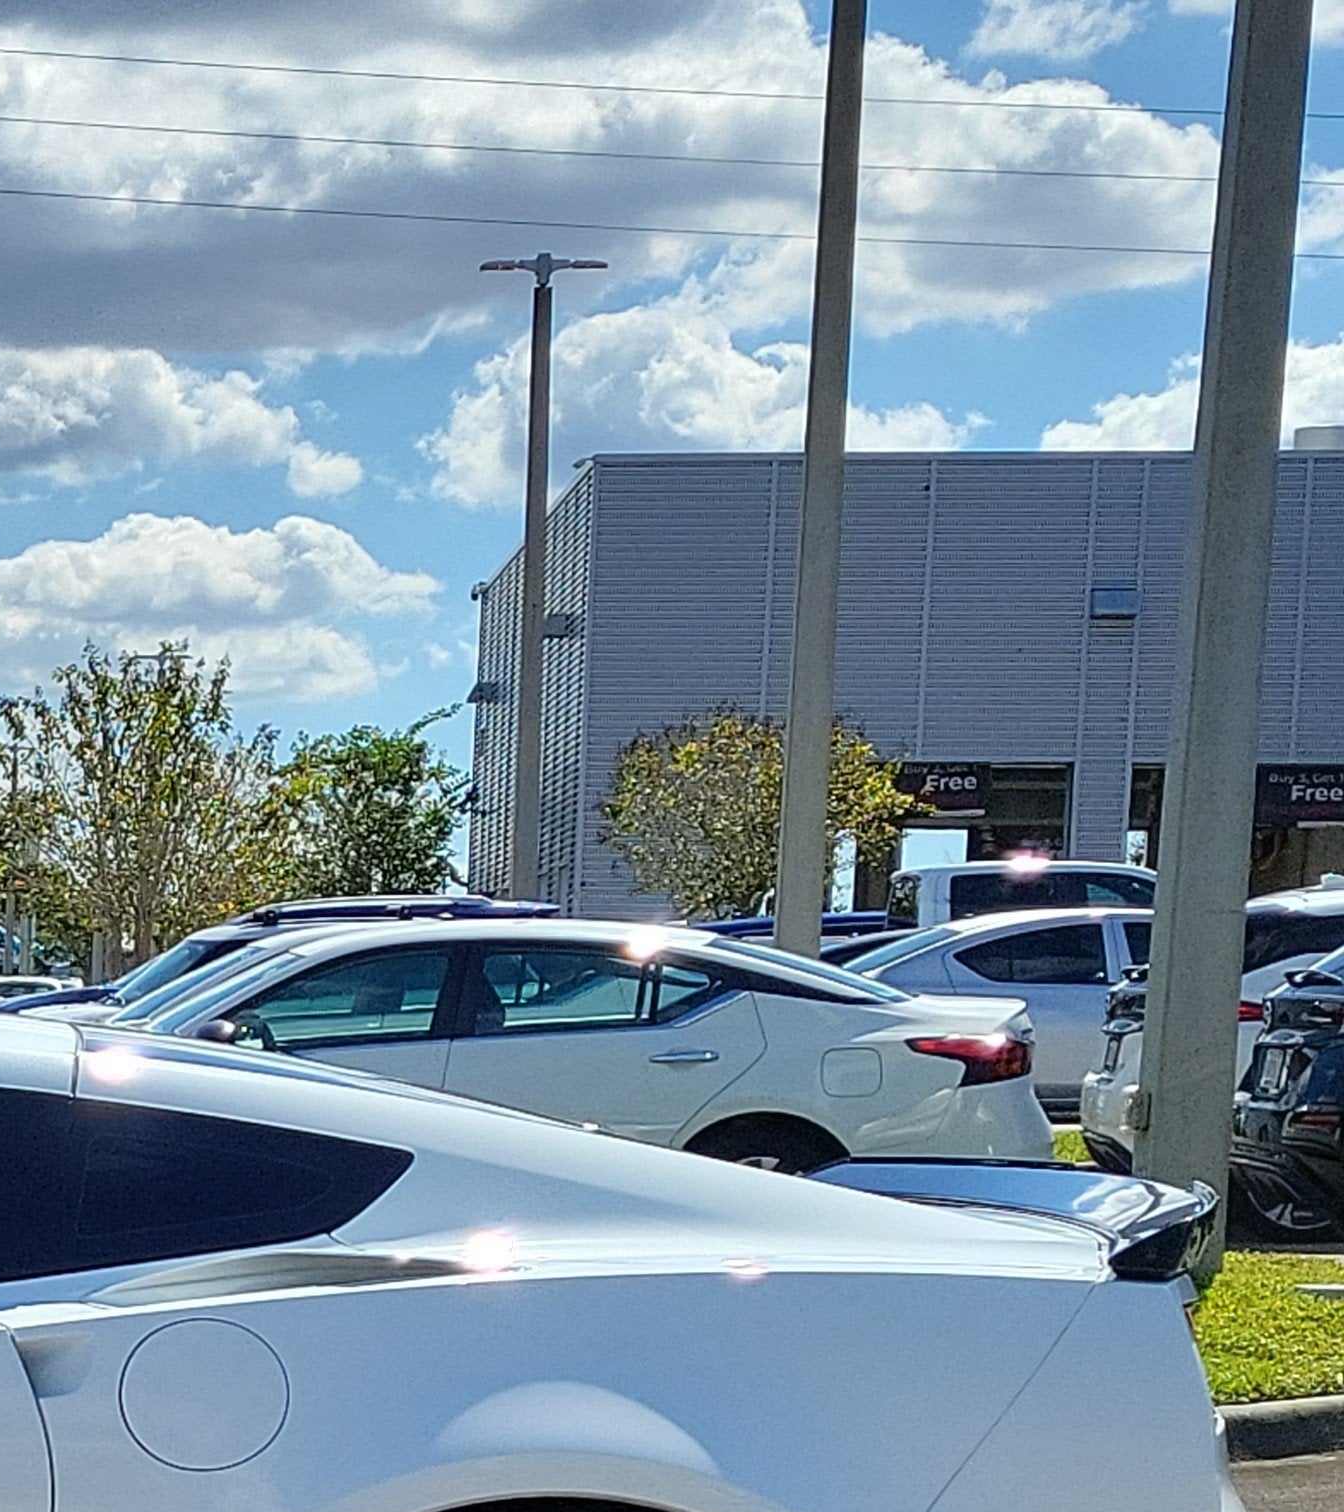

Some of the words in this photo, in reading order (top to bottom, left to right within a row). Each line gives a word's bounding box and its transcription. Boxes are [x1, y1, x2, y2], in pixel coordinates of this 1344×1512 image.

[925, 774, 978, 792] Free
[1268, 772, 1295, 784] Buy
[1291, 784, 1344, 801] Free
